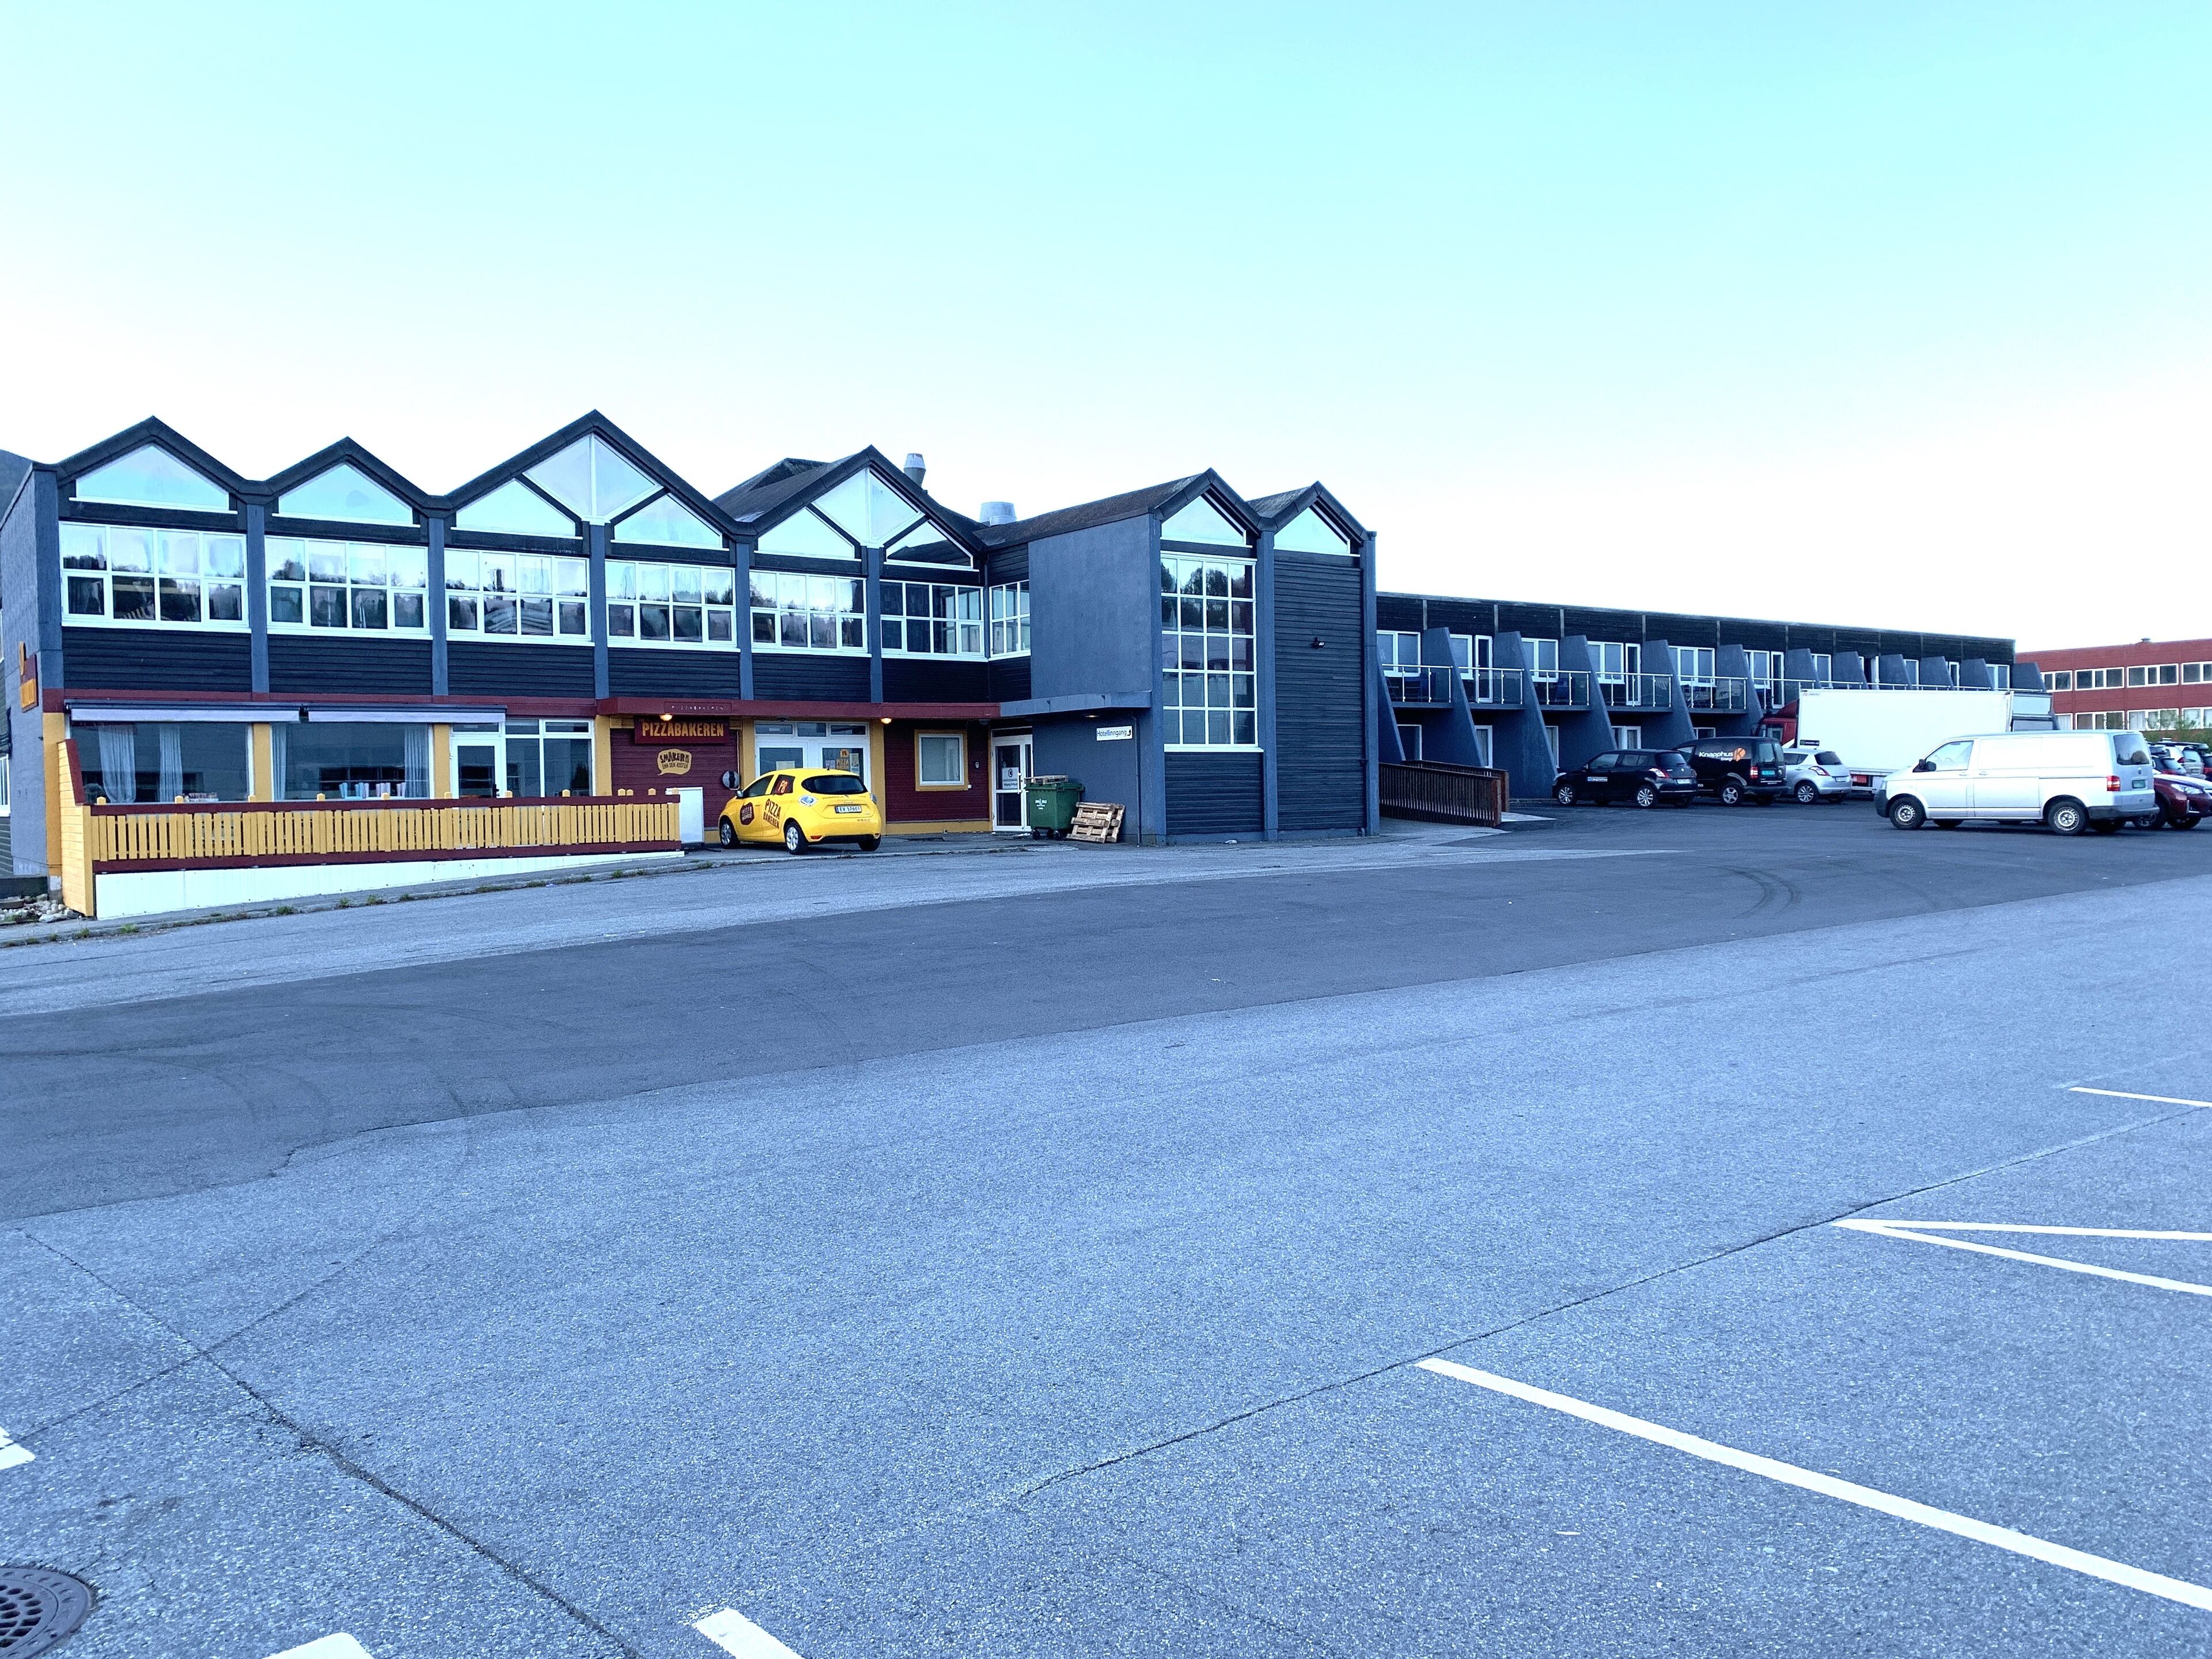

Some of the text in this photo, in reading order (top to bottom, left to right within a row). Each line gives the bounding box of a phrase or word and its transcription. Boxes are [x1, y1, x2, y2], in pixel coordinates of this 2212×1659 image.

[642, 722, 724, 737] PIZZABAKEREN
[1097, 729, 1127, 737] Hotellinngang
[660, 752, 685, 763] SMAKER
[764, 798, 781, 820] PIZZA
[763, 811, 779, 830] BAKEREN
